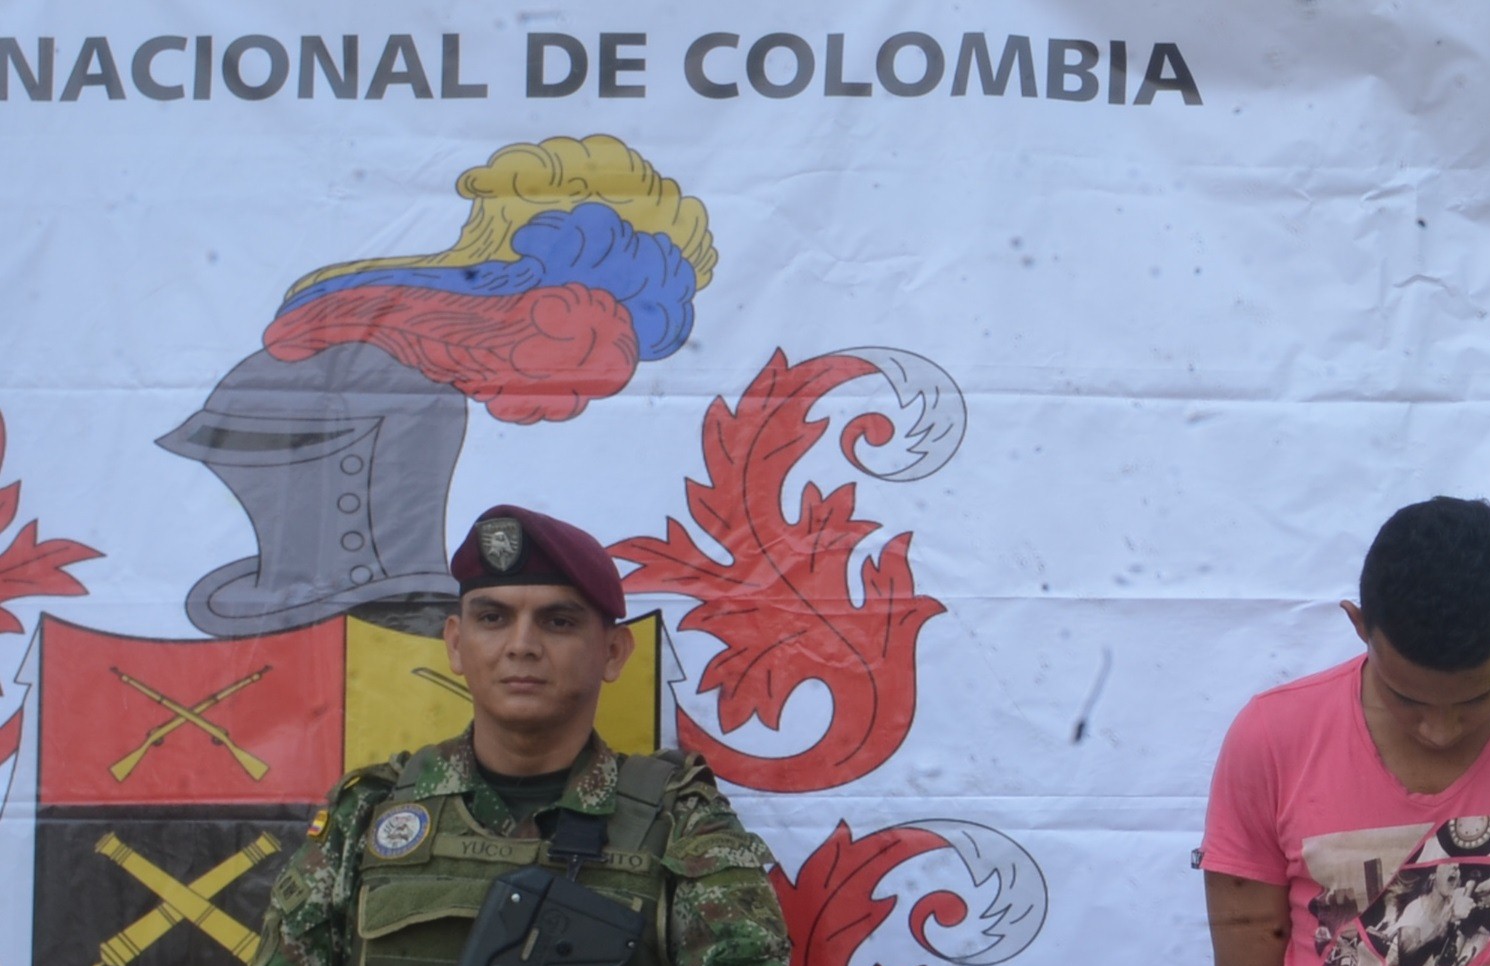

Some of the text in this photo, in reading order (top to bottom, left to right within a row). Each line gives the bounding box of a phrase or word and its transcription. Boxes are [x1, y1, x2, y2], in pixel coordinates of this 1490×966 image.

[0, 31, 1204, 106] NACIONAL DE COLOMBIA
